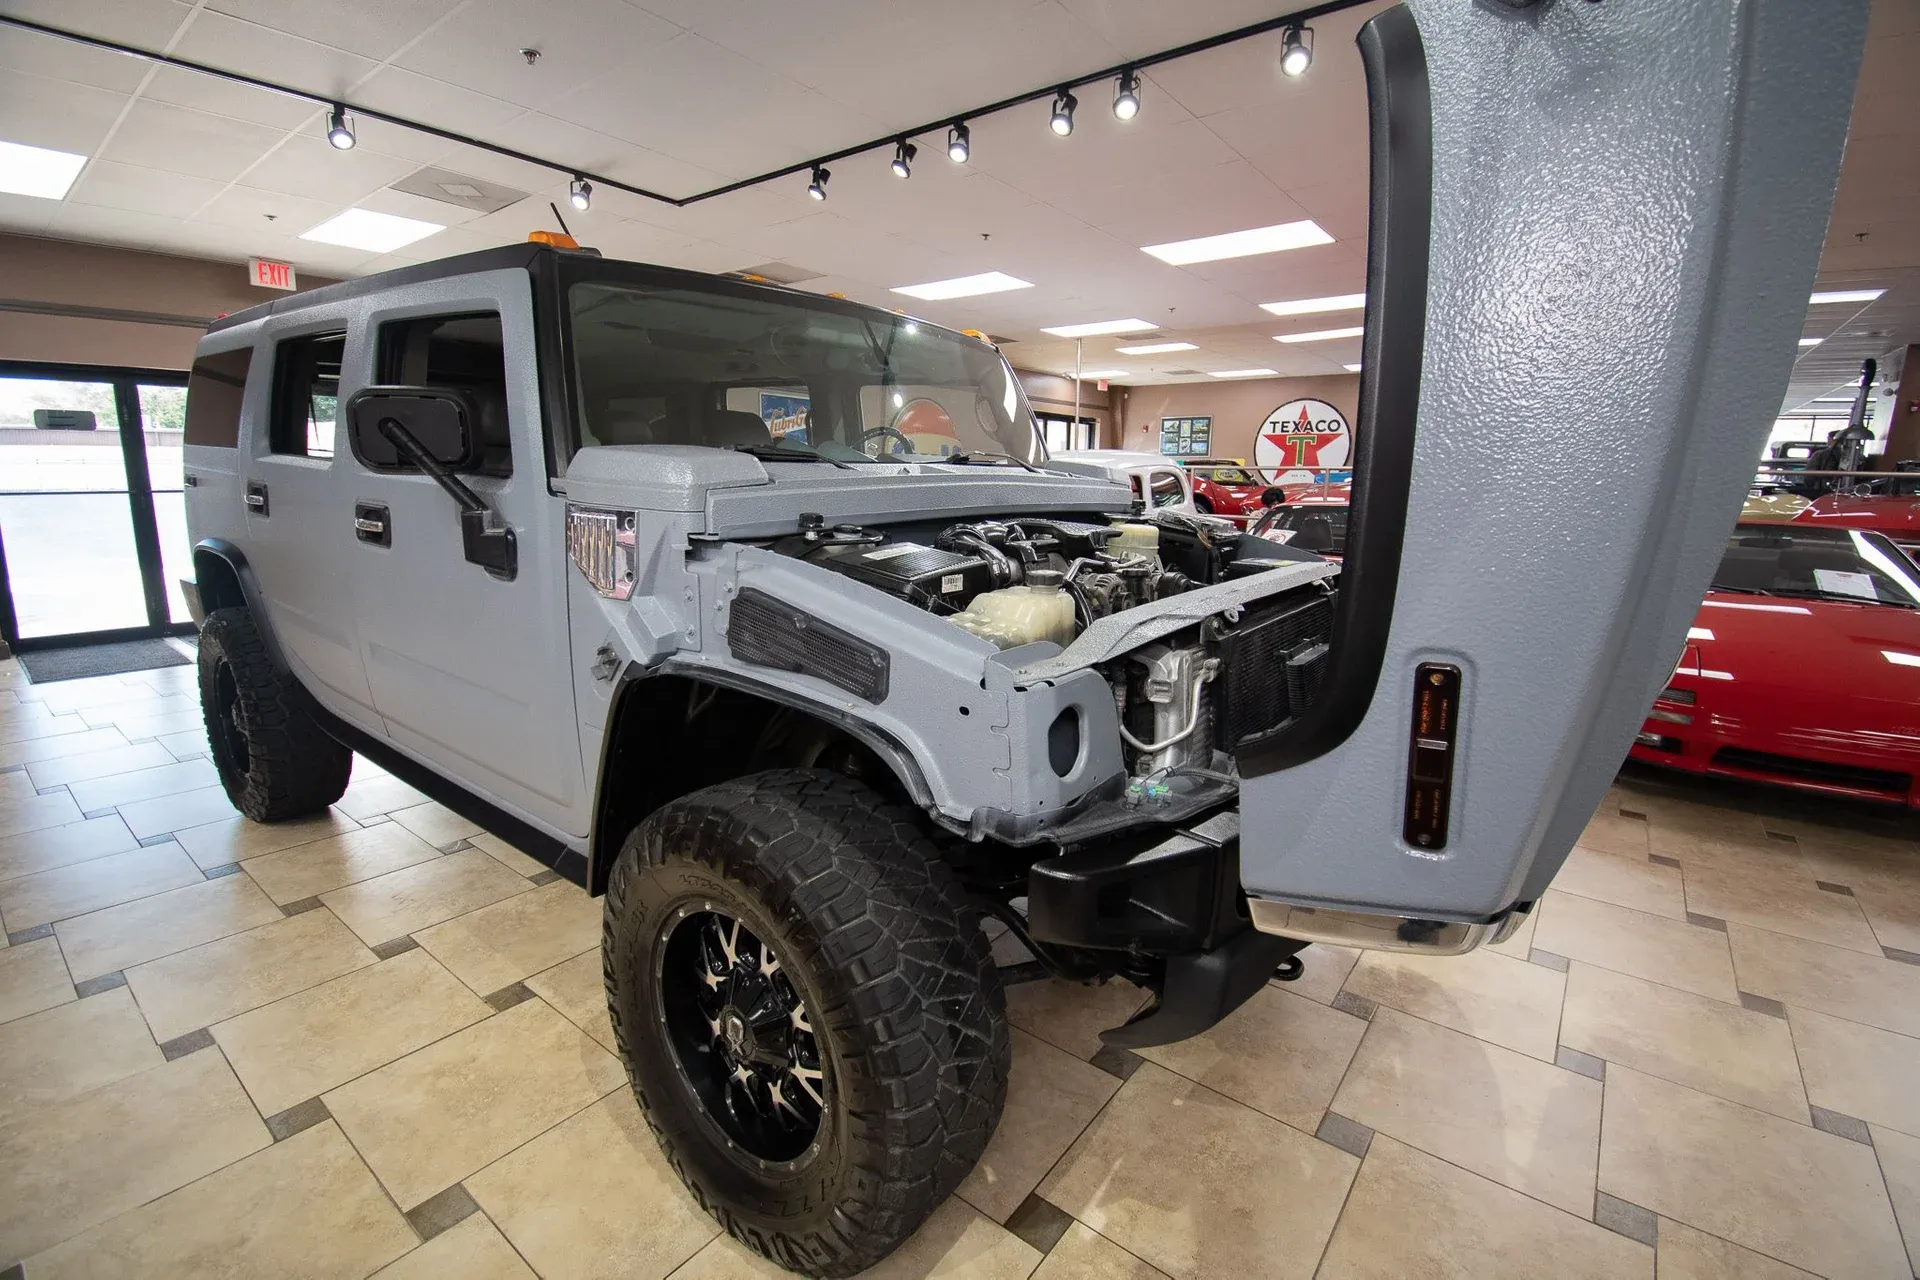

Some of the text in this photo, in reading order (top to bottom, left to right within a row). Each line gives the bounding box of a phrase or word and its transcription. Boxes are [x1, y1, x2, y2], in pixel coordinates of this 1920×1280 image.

[257, 261, 290, 287] EXIT
[1269, 419, 1341, 433] TEXACO
[1286, 435, 1317, 466] T
